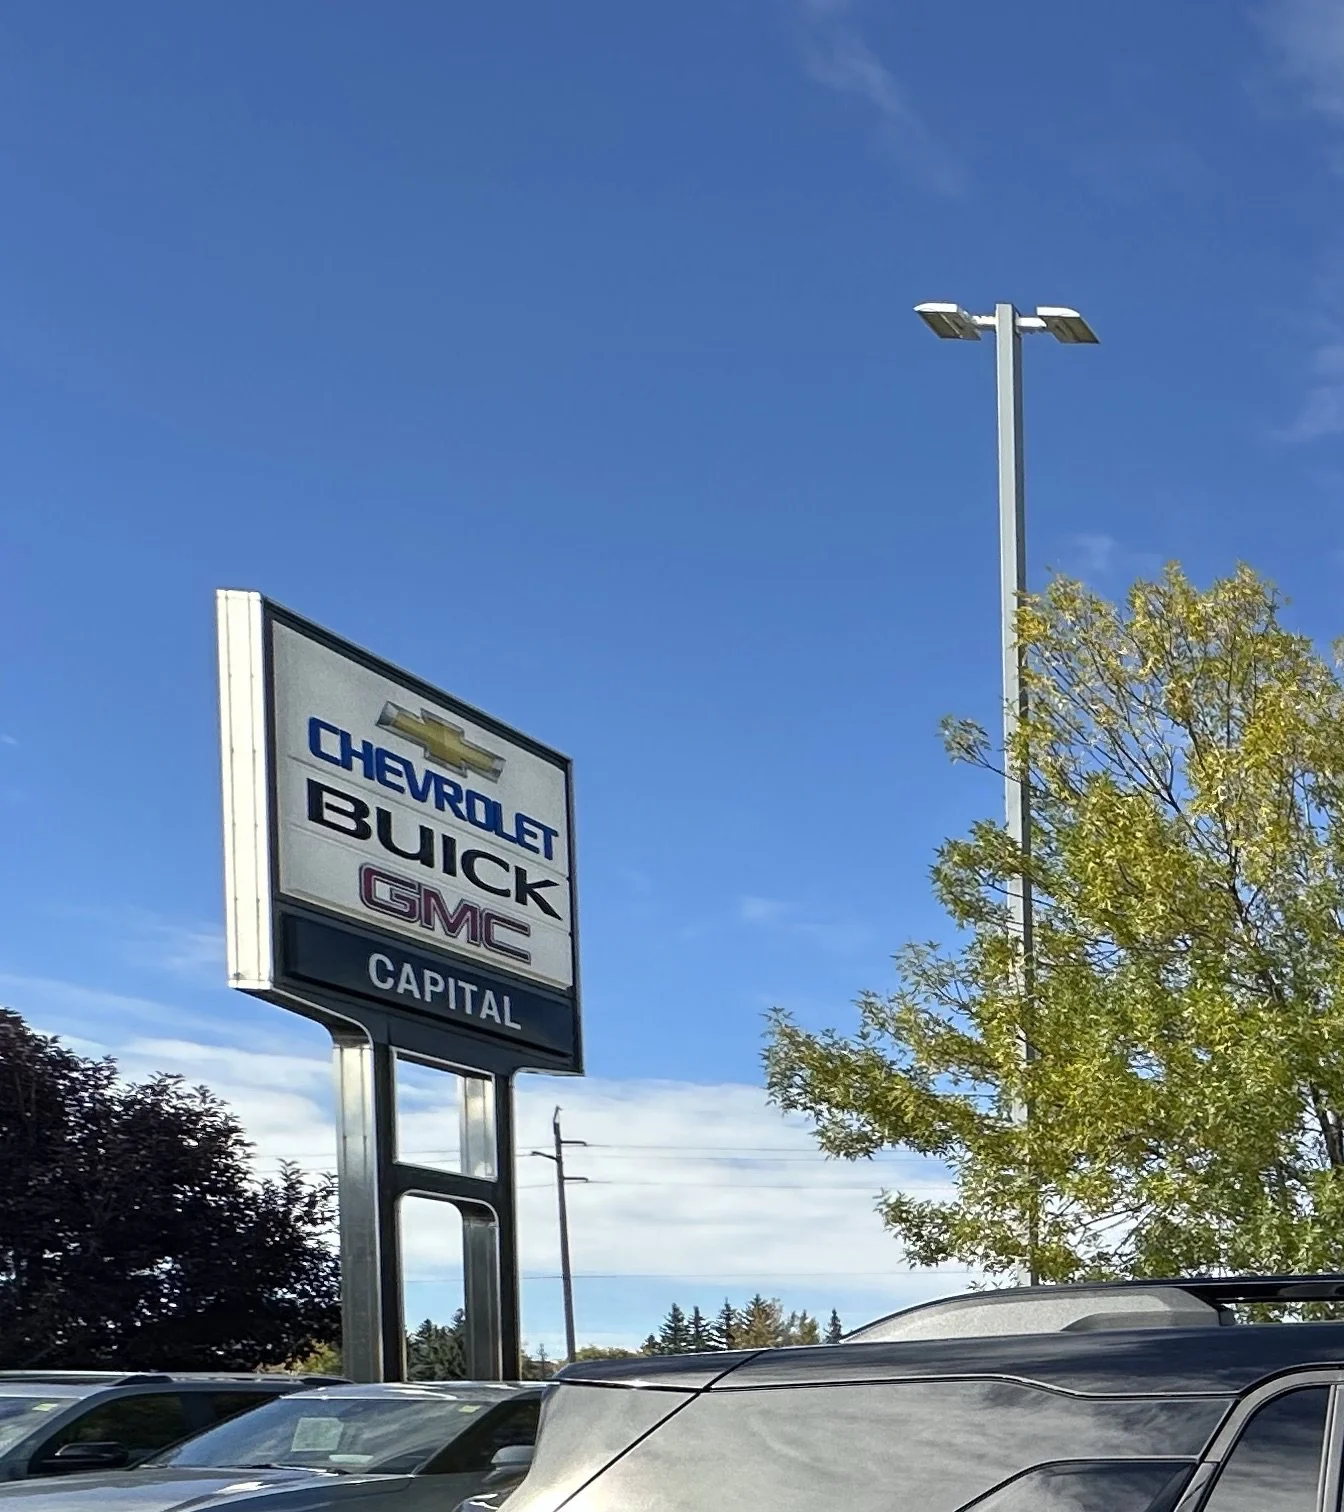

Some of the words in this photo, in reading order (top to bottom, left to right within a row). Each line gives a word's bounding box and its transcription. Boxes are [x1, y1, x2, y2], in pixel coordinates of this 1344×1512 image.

[306, 778, 563, 920] BUICK
[308, 716, 559, 861] CHEVROLET
[359, 862, 531, 965] GMC
[368, 953, 522, 1031] CAPITAL
